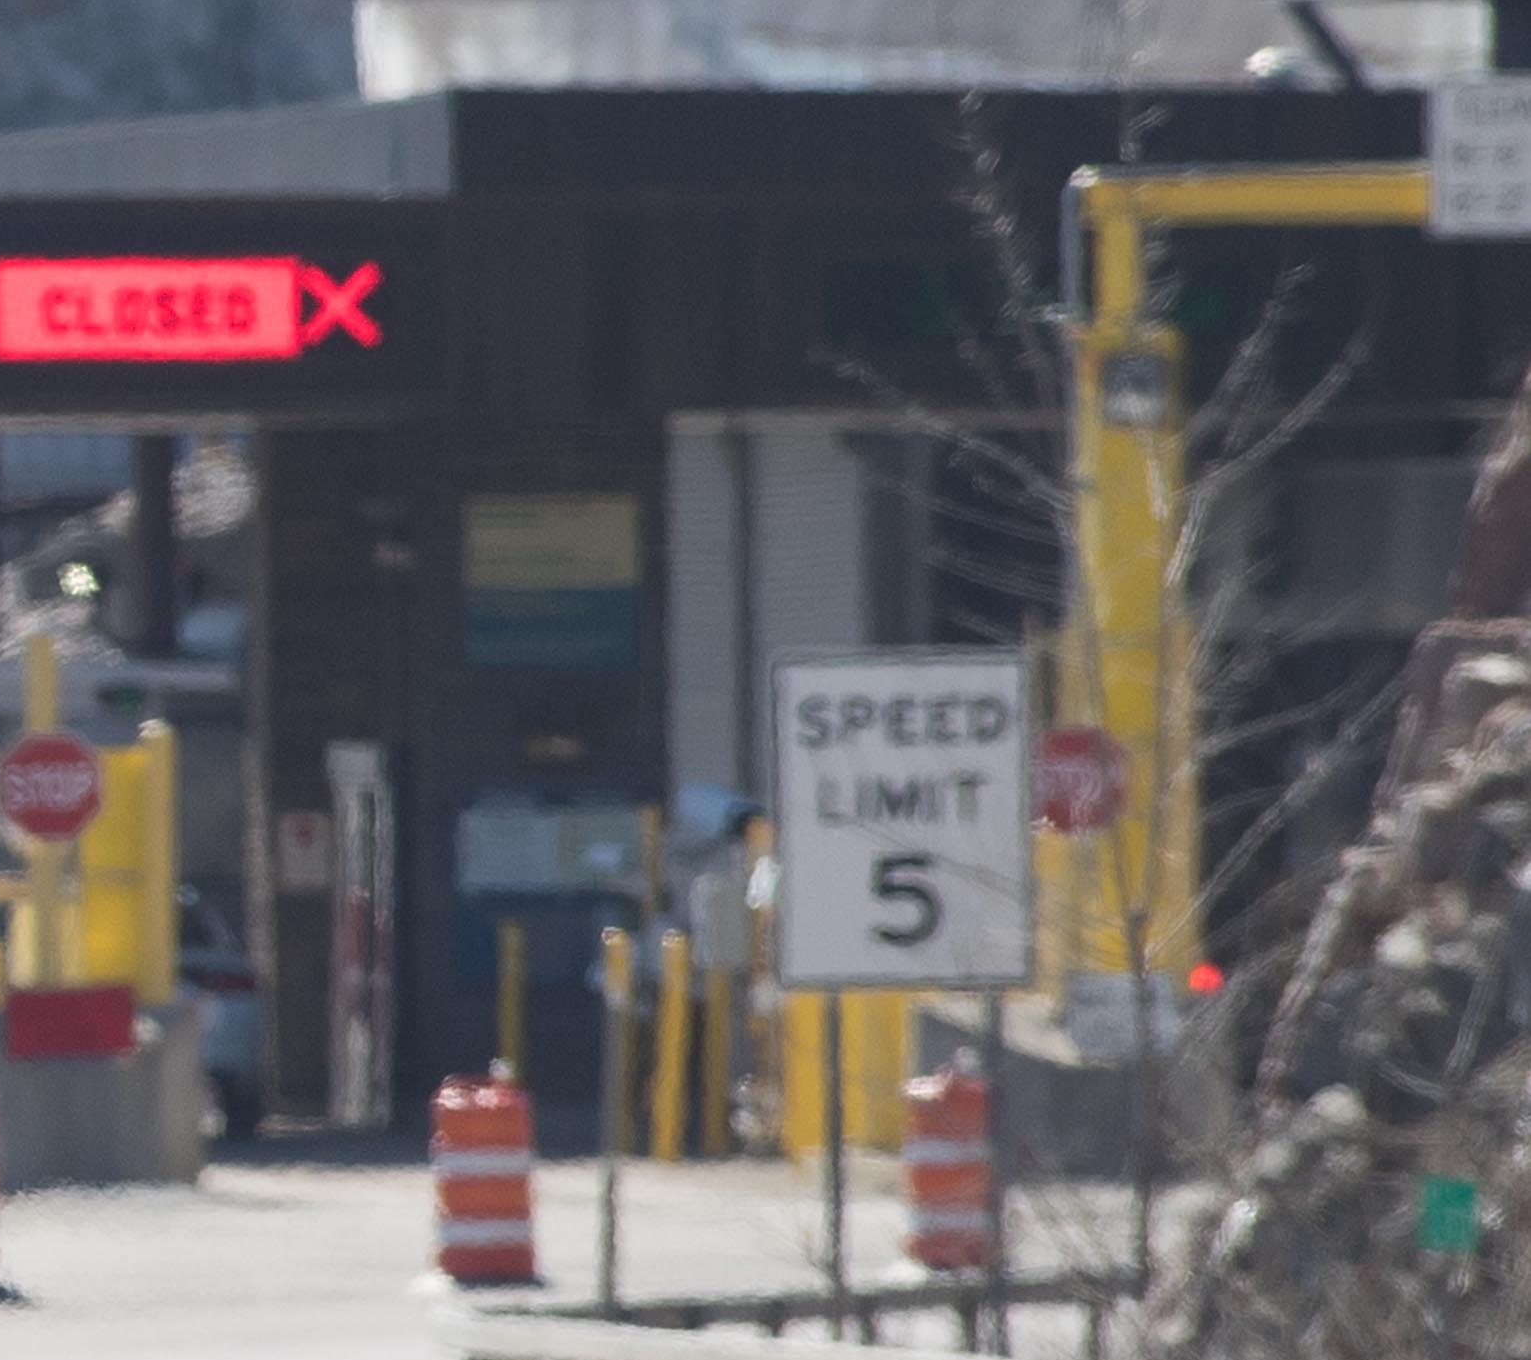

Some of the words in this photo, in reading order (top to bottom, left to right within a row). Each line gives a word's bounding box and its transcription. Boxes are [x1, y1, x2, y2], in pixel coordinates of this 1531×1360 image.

[39, 285, 258, 336] CLOSED
[796, 696, 1007, 748] SPEED
[5, 762, 95, 809] STOP
[815, 771, 987, 826] LIMIT
[869, 850, 943, 947] 5
